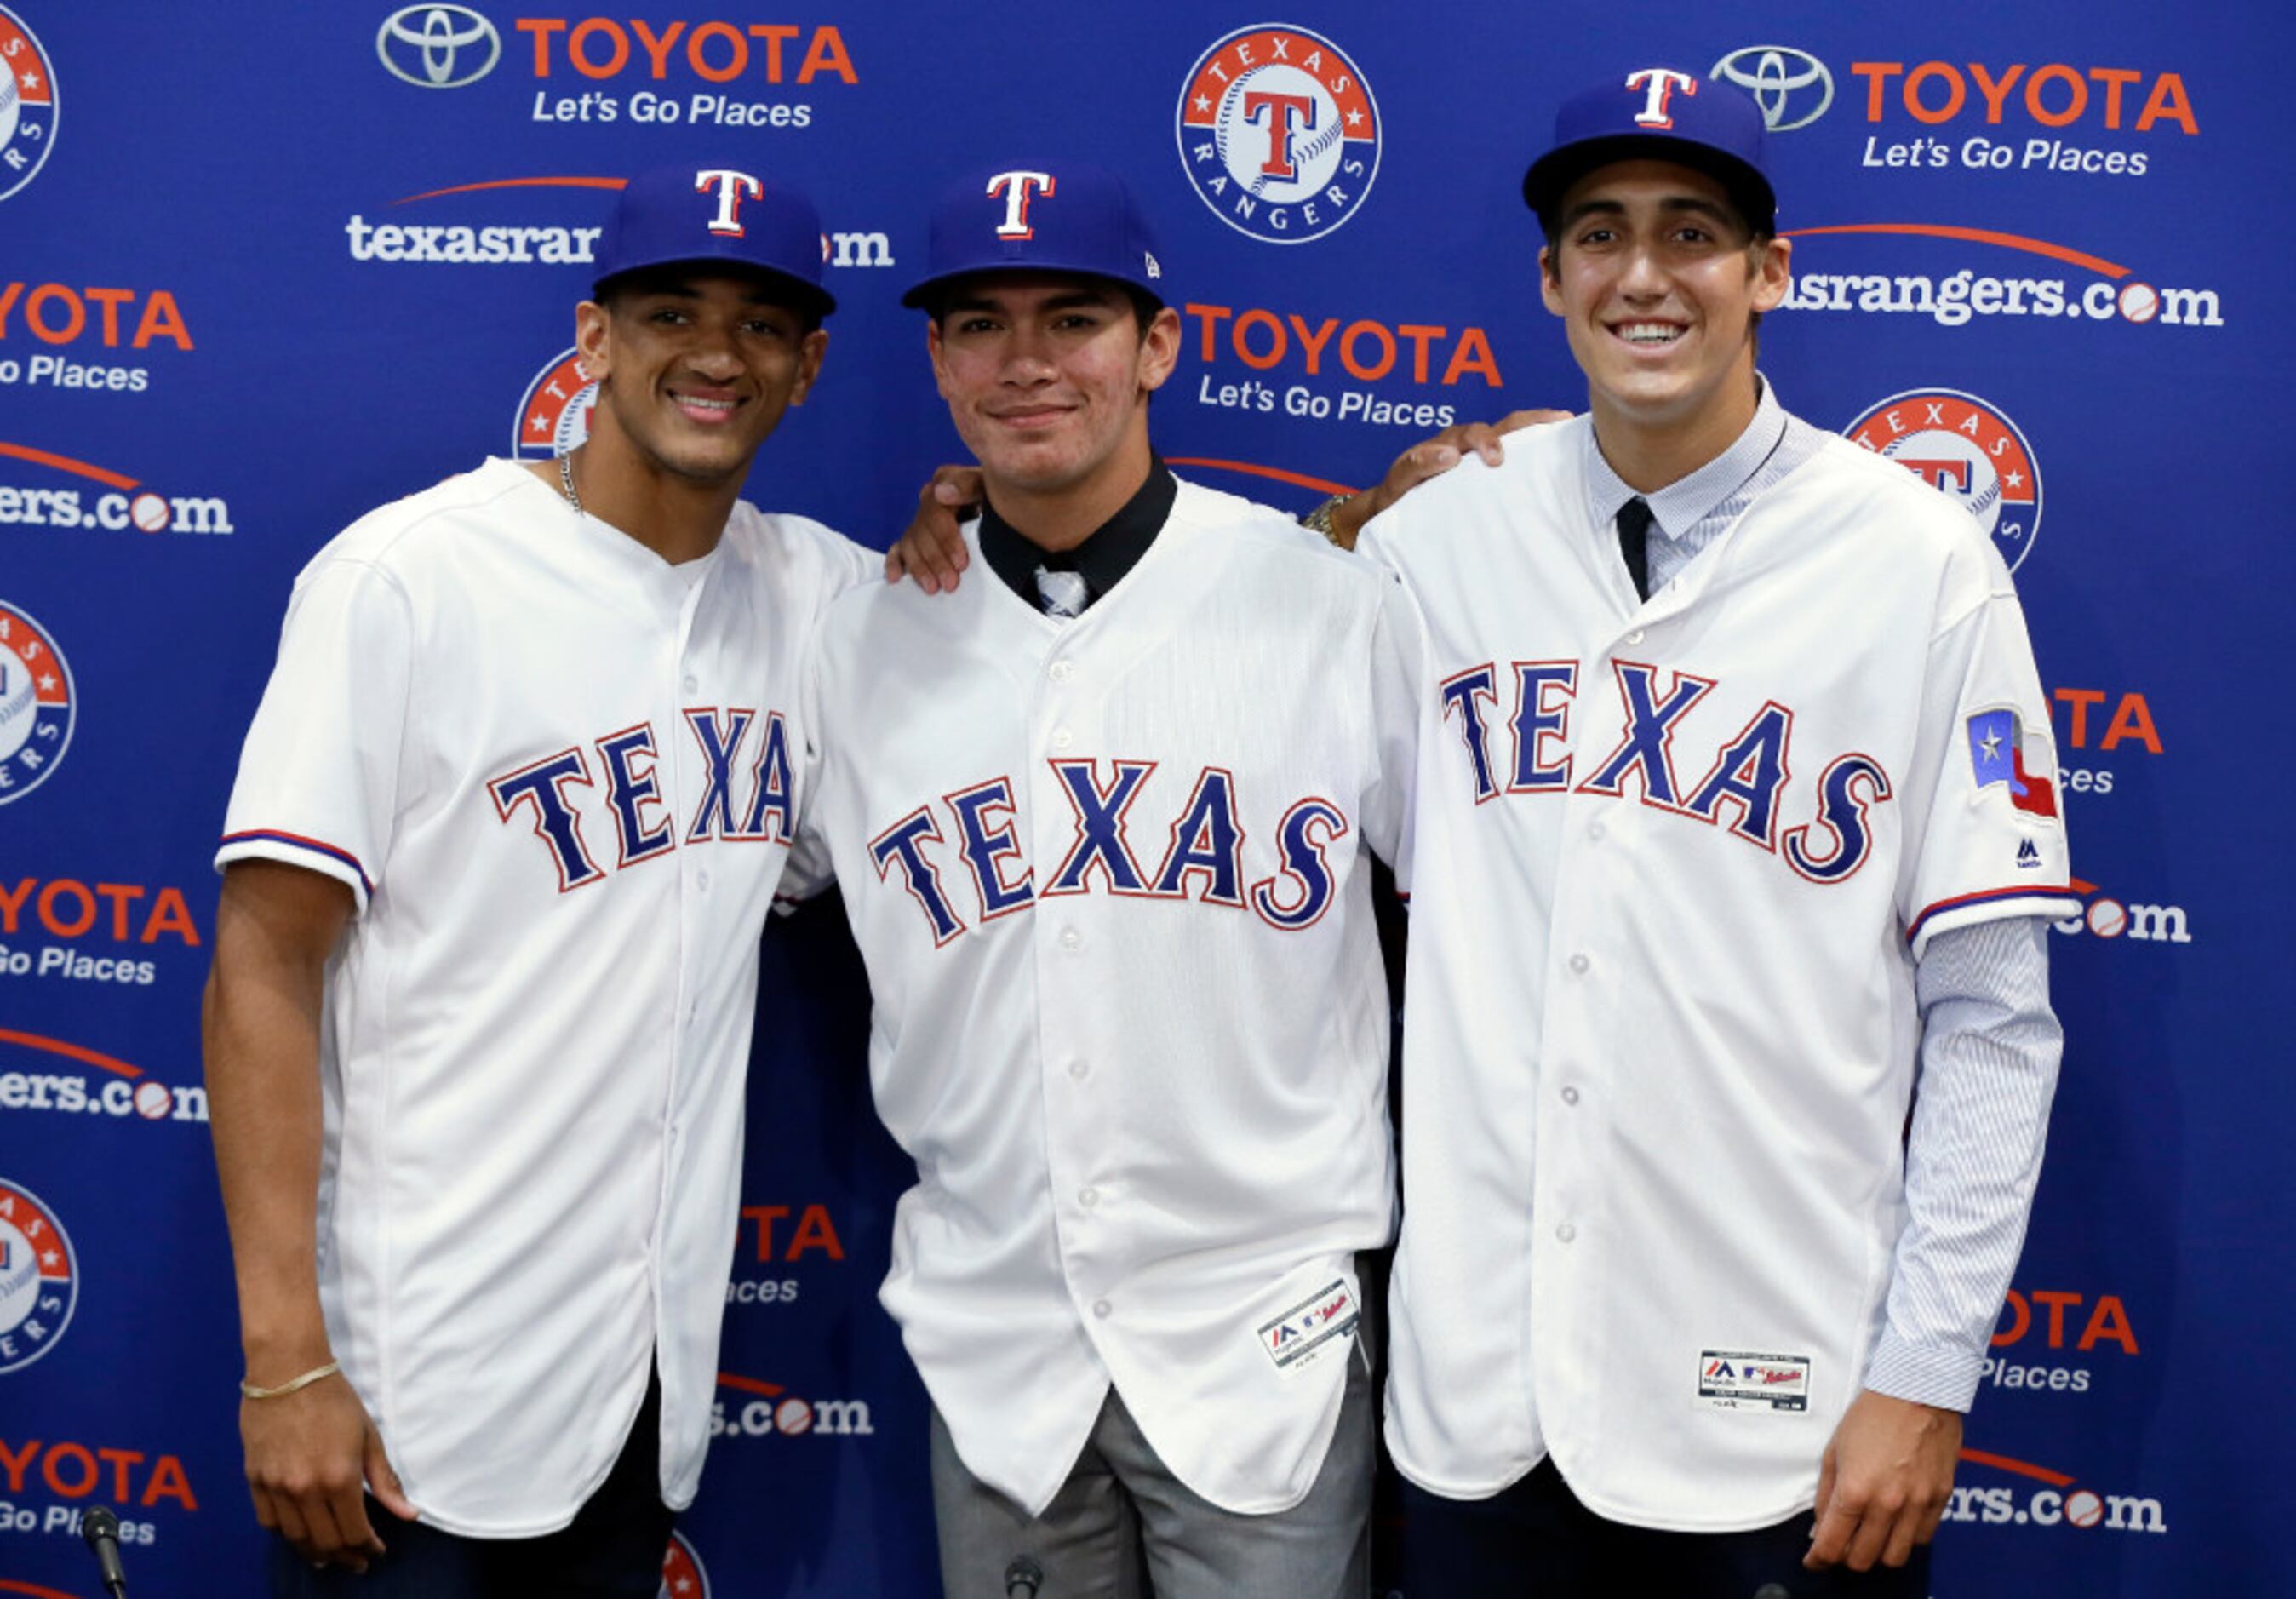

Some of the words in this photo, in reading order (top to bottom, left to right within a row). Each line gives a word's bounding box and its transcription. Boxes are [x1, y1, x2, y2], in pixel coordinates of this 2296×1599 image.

[516, 17, 859, 84] TOYOTA
[1207, 37, 1351, 94] TEXAS
[532, 91, 618, 122] Let's
[629, 91, 680, 123] Go
[688, 95, 811, 128] Places
[1625, 68, 1698, 130] T
[1851, 60, 2200, 135] TOYOTA
[1244, 91, 1317, 184] T
[1862, 136, 1950, 168] Let's
[1961, 137, 2013, 169] Go
[2021, 139, 2149, 175] Places
[695, 170, 763, 238] T
[986, 171, 1056, 240] T
[1194, 143, 1364, 230] RANGERS
[27, 354, 148, 392] Places
[1185, 302, 1503, 387] TOYOTA
[1199, 375, 1274, 412] Let's
[1285, 386, 1331, 419] Go
[1337, 391, 1456, 427] Places
[1855, 403, 2011, 456] TEXAS
[486, 707, 796, 893] TEXA
[1440, 657, 1892, 885] TEXAS
[867, 758, 1348, 949] TEXAS
[37, 947, 155, 984] Places
